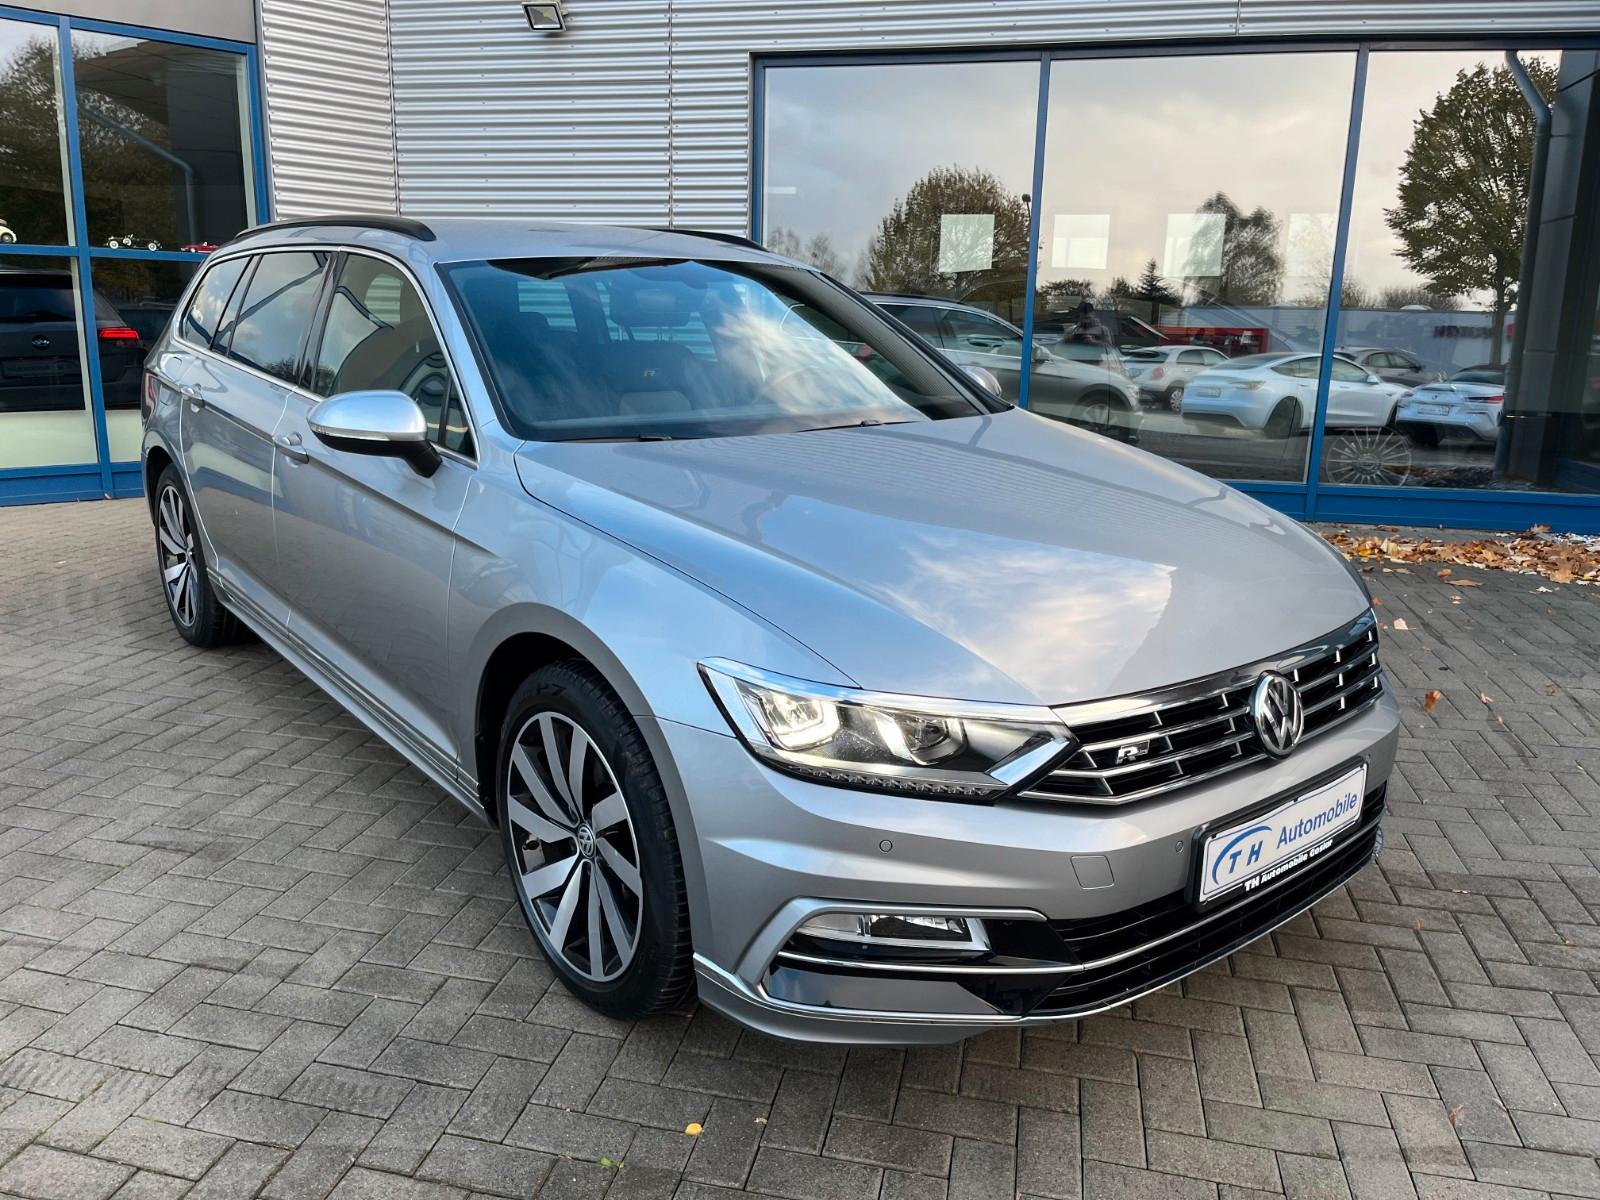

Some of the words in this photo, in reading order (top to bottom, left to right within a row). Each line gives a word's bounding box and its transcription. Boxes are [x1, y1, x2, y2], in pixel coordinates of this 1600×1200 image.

[1276, 792, 1358, 850] Automobile
[1244, 876, 1260, 892] TH
[1261, 853, 1309, 883] Automobile
